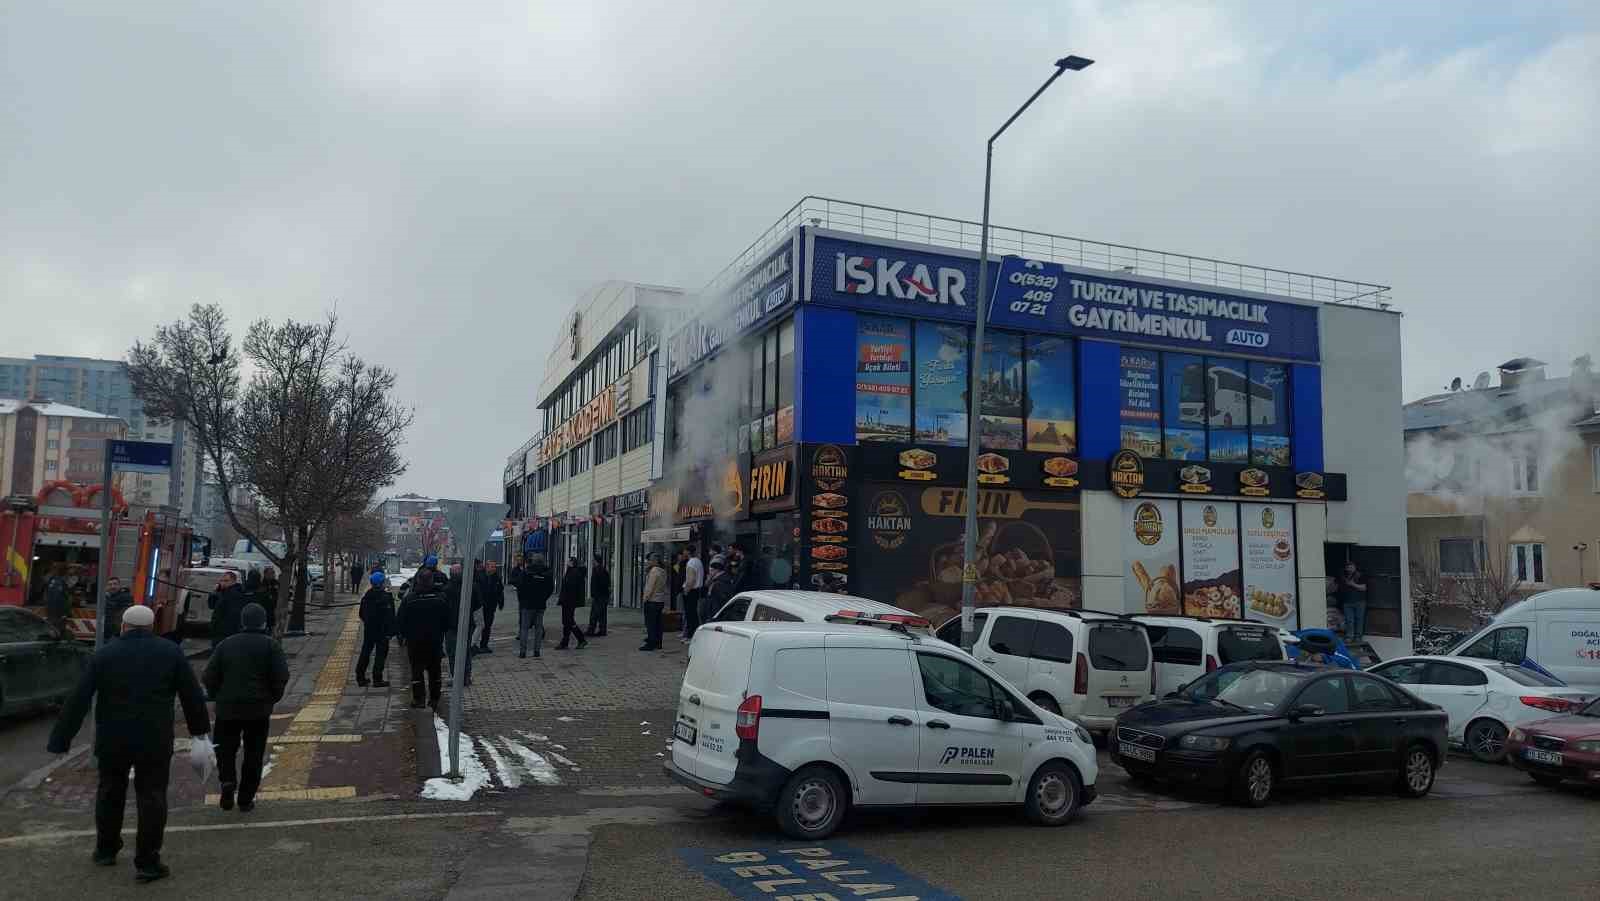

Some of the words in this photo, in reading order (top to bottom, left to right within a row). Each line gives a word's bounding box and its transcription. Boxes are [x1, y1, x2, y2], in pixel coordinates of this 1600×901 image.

[835, 252, 967, 306] İSKAR
[1008, 271, 1059, 288] 0(532)
[1022, 289, 1054, 303] 409
[1069, 279, 1138, 305] TURİZM
[1138, 291, 1164, 310] VE
[1165, 293, 1269, 324] TAŞIMACILIK
[1009, 300, 1028, 312] 07
[1029, 303, 1048, 316] 21
[1069, 304, 1213, 343] GAYRİMENKUL
[1231, 329, 1265, 347] AUTO
[811, 464, 848, 478] HAKTAN
[1111, 470, 1144, 485] HAKTAN
[750, 460, 787, 501] FIRIN
[867, 516, 912, 531] HAKTAN
[961, 747, 995, 759] PALEN
